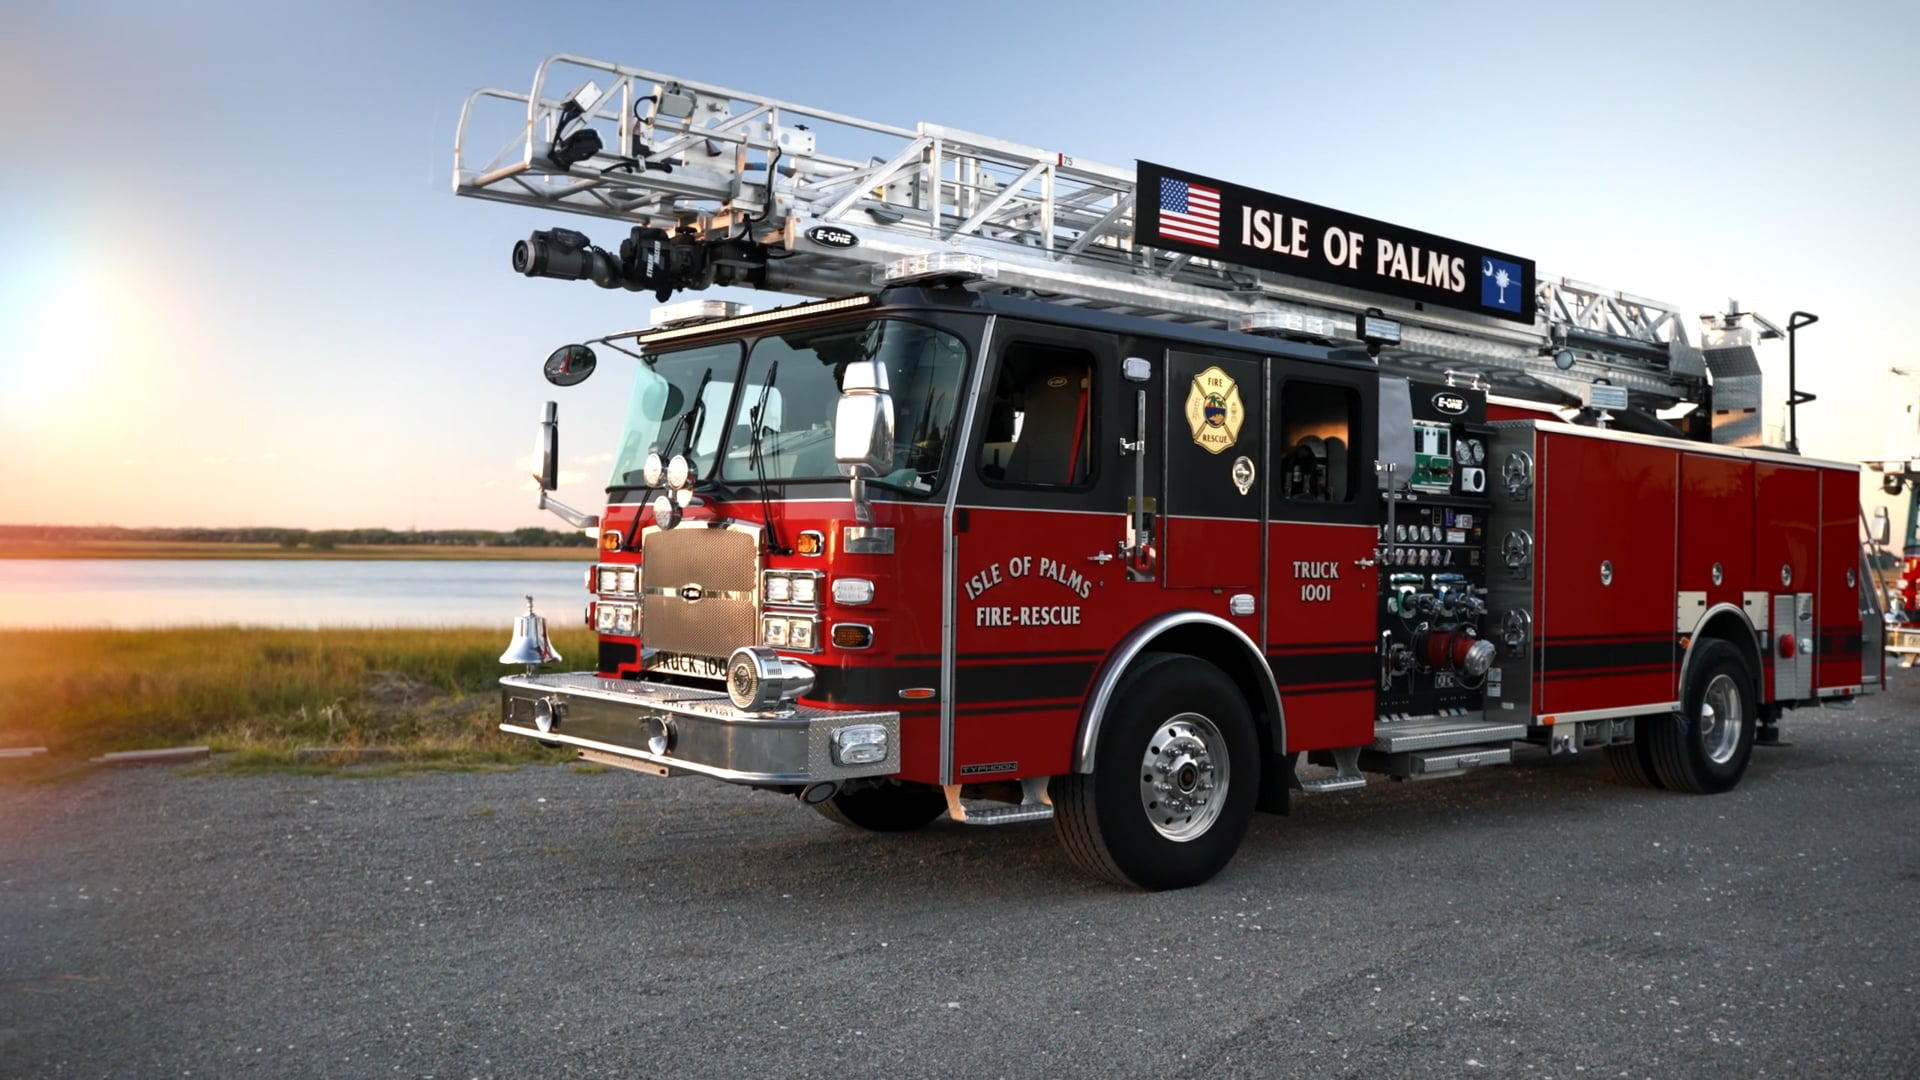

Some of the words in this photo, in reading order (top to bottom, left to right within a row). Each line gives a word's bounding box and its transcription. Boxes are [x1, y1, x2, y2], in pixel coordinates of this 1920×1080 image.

[1063, 155, 1073, 166] 75
[816, 229, 852, 245] E-ONE
[1241, 205, 1309, 258] ISLE
[1323, 226, 1364, 269] OF
[1376, 238, 1466, 293] PALMS
[1207, 377, 1223, 388] FIRE
[1438, 397, 1463, 410] E-ONE
[1202, 433, 1228, 444] RESCUE
[1293, 561, 1339, 578] TRUCK
[965, 563, 1002, 600] ISLE
[1009, 556, 1032, 577] OF
[1040, 557, 1092, 599] PALMS
[1301, 584, 1331, 601] 1001
[976, 606, 1081, 626] FIRE-RESCUE
[656, 651, 696, 673] TRUCK
[962, 763, 1016, 773] TYPHOON
